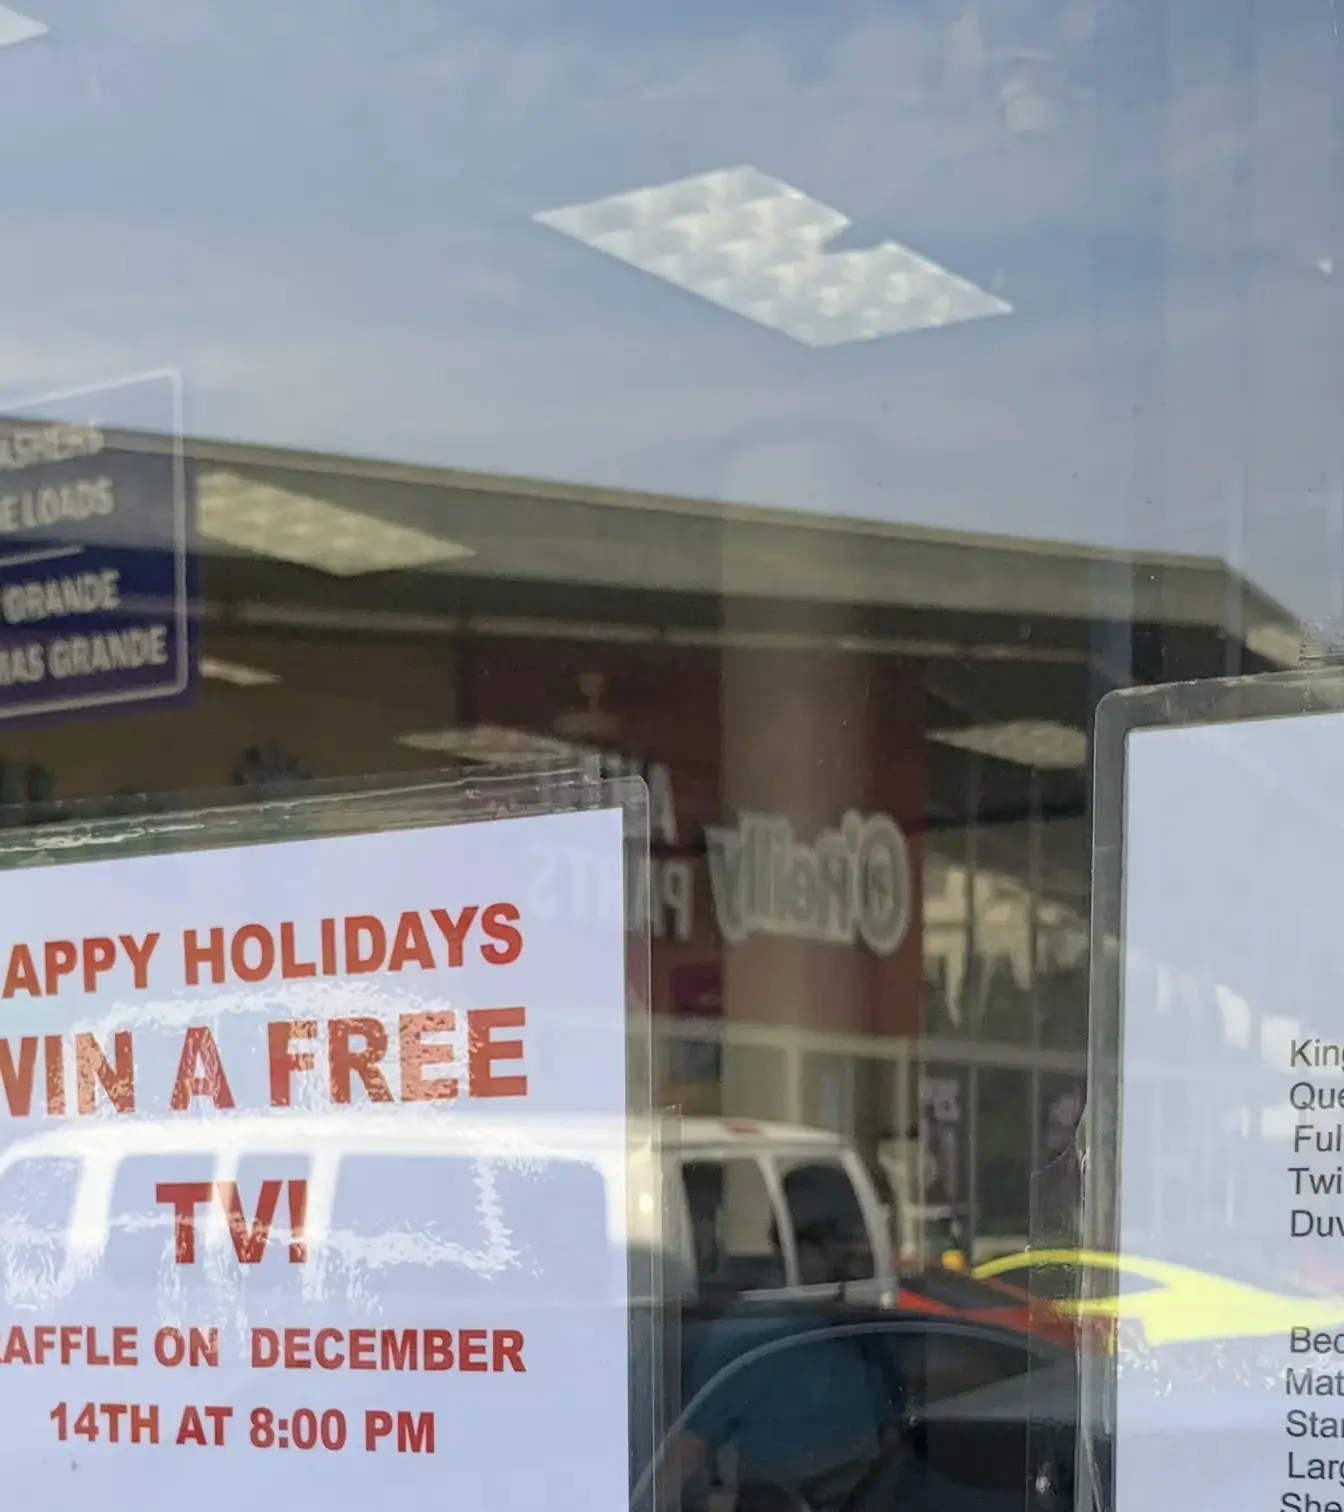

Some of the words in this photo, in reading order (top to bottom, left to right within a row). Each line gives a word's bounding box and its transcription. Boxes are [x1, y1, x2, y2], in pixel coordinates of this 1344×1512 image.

[22, 477, 113, 527] LOADS
[3, 569, 121, 624] GRANDE
[48, 625, 167, 677] GRANDE
[182, 902, 523, 986] HOLIDAYS
[169, 1025, 236, 1111] A
[267, 1006, 528, 1108] FREE
[155, 1179, 308, 1266] TV!
[153, 1326, 219, 1368] ON
[251, 1327, 527, 1373] DECEMBER
[49, 1401, 160, 1445] 14TH
[175, 1405, 234, 1447] AT
[249, 1406, 347, 1452] 8:00
[364, 1409, 435, 1454] PM
